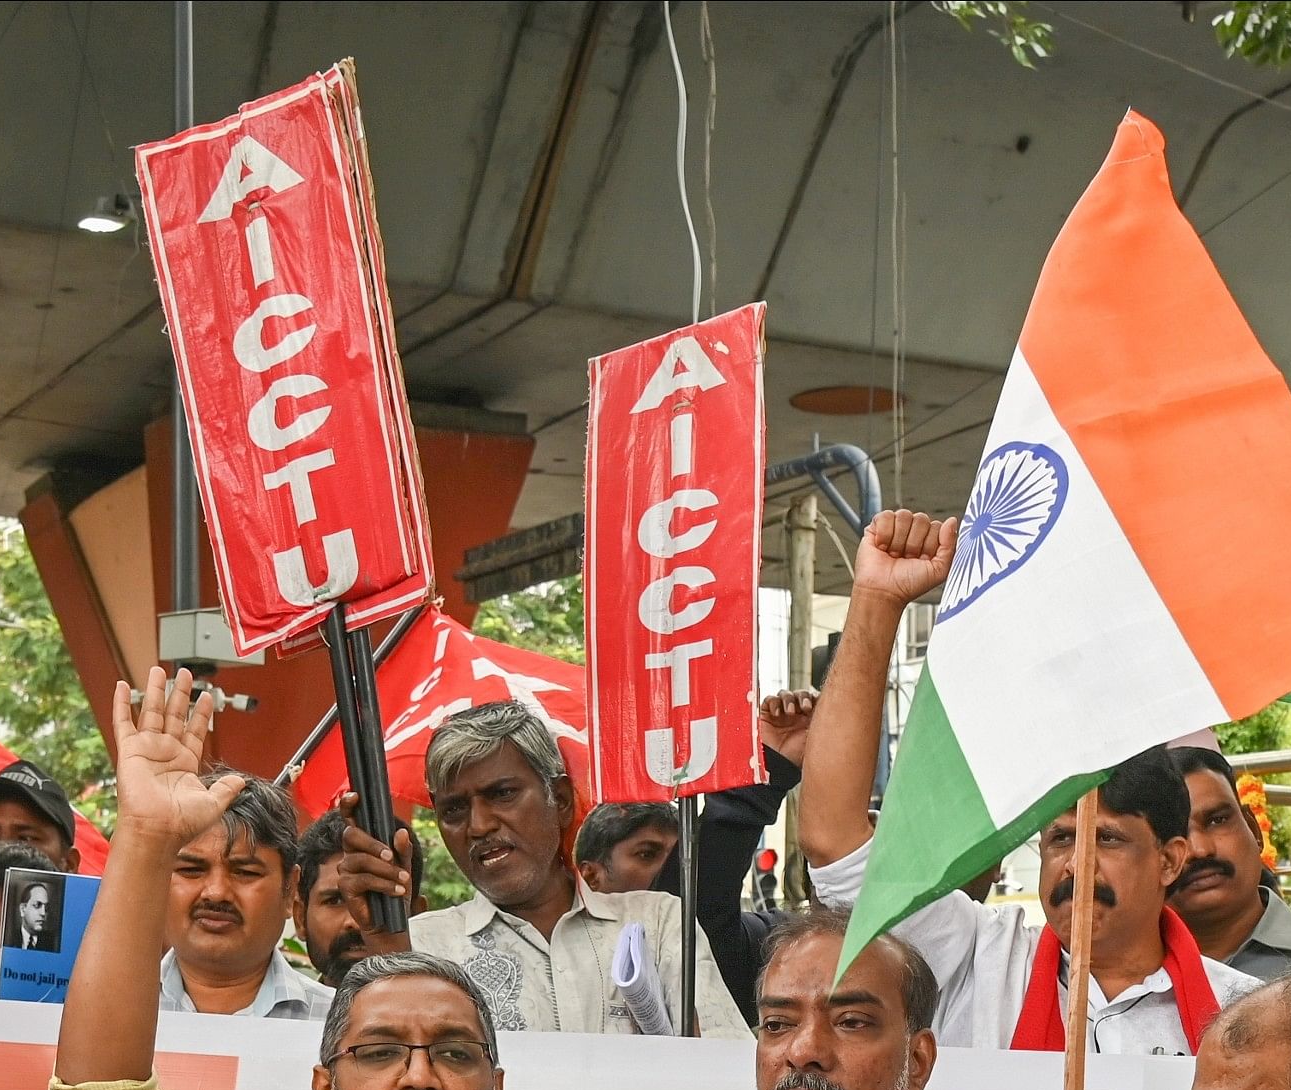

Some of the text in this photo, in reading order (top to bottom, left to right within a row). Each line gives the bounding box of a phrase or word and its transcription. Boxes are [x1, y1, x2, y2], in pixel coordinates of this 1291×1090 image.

[198, 134, 358, 607] AICCTU
[629, 335, 726, 787] AICCTU
[4, 967, 18, 980] Do
[20, 971, 36, 983] not
[37, 972, 55, 987] jail
